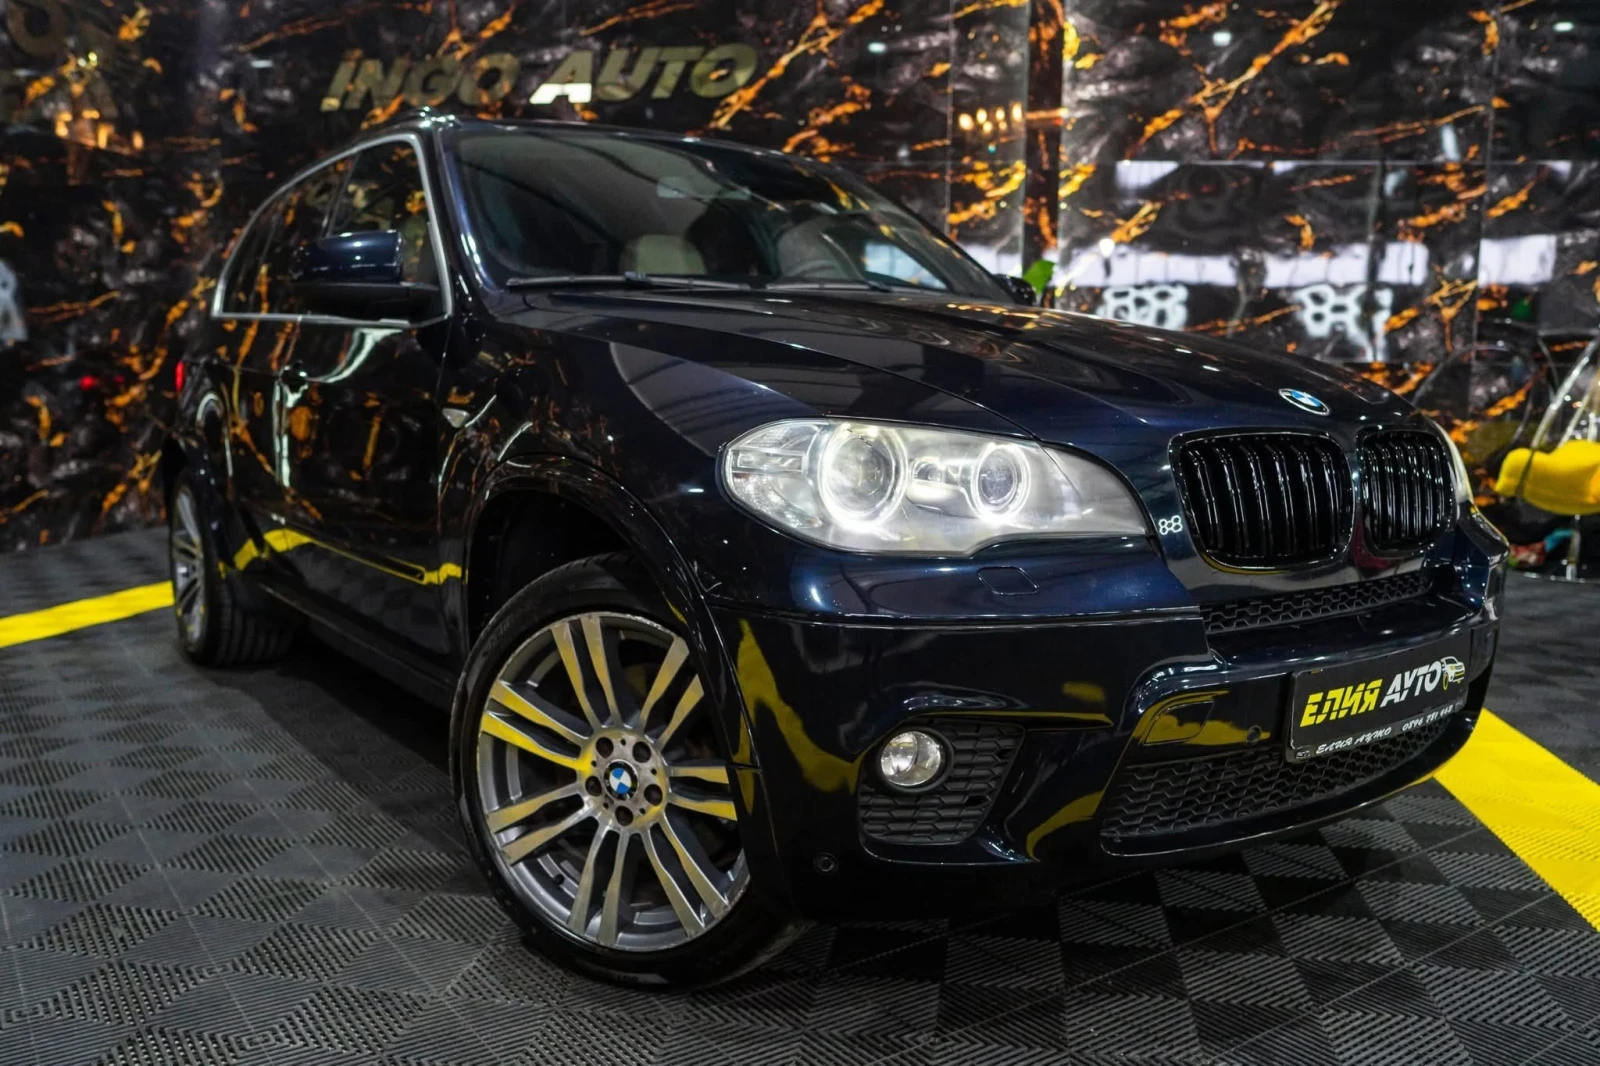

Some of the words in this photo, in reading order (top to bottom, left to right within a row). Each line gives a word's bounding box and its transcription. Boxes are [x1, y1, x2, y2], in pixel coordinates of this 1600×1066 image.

[319, 52, 521, 112] INGO
[529, 43, 758, 104] AUTO
[1300, 678, 1383, 728] ЕЛИЯ
